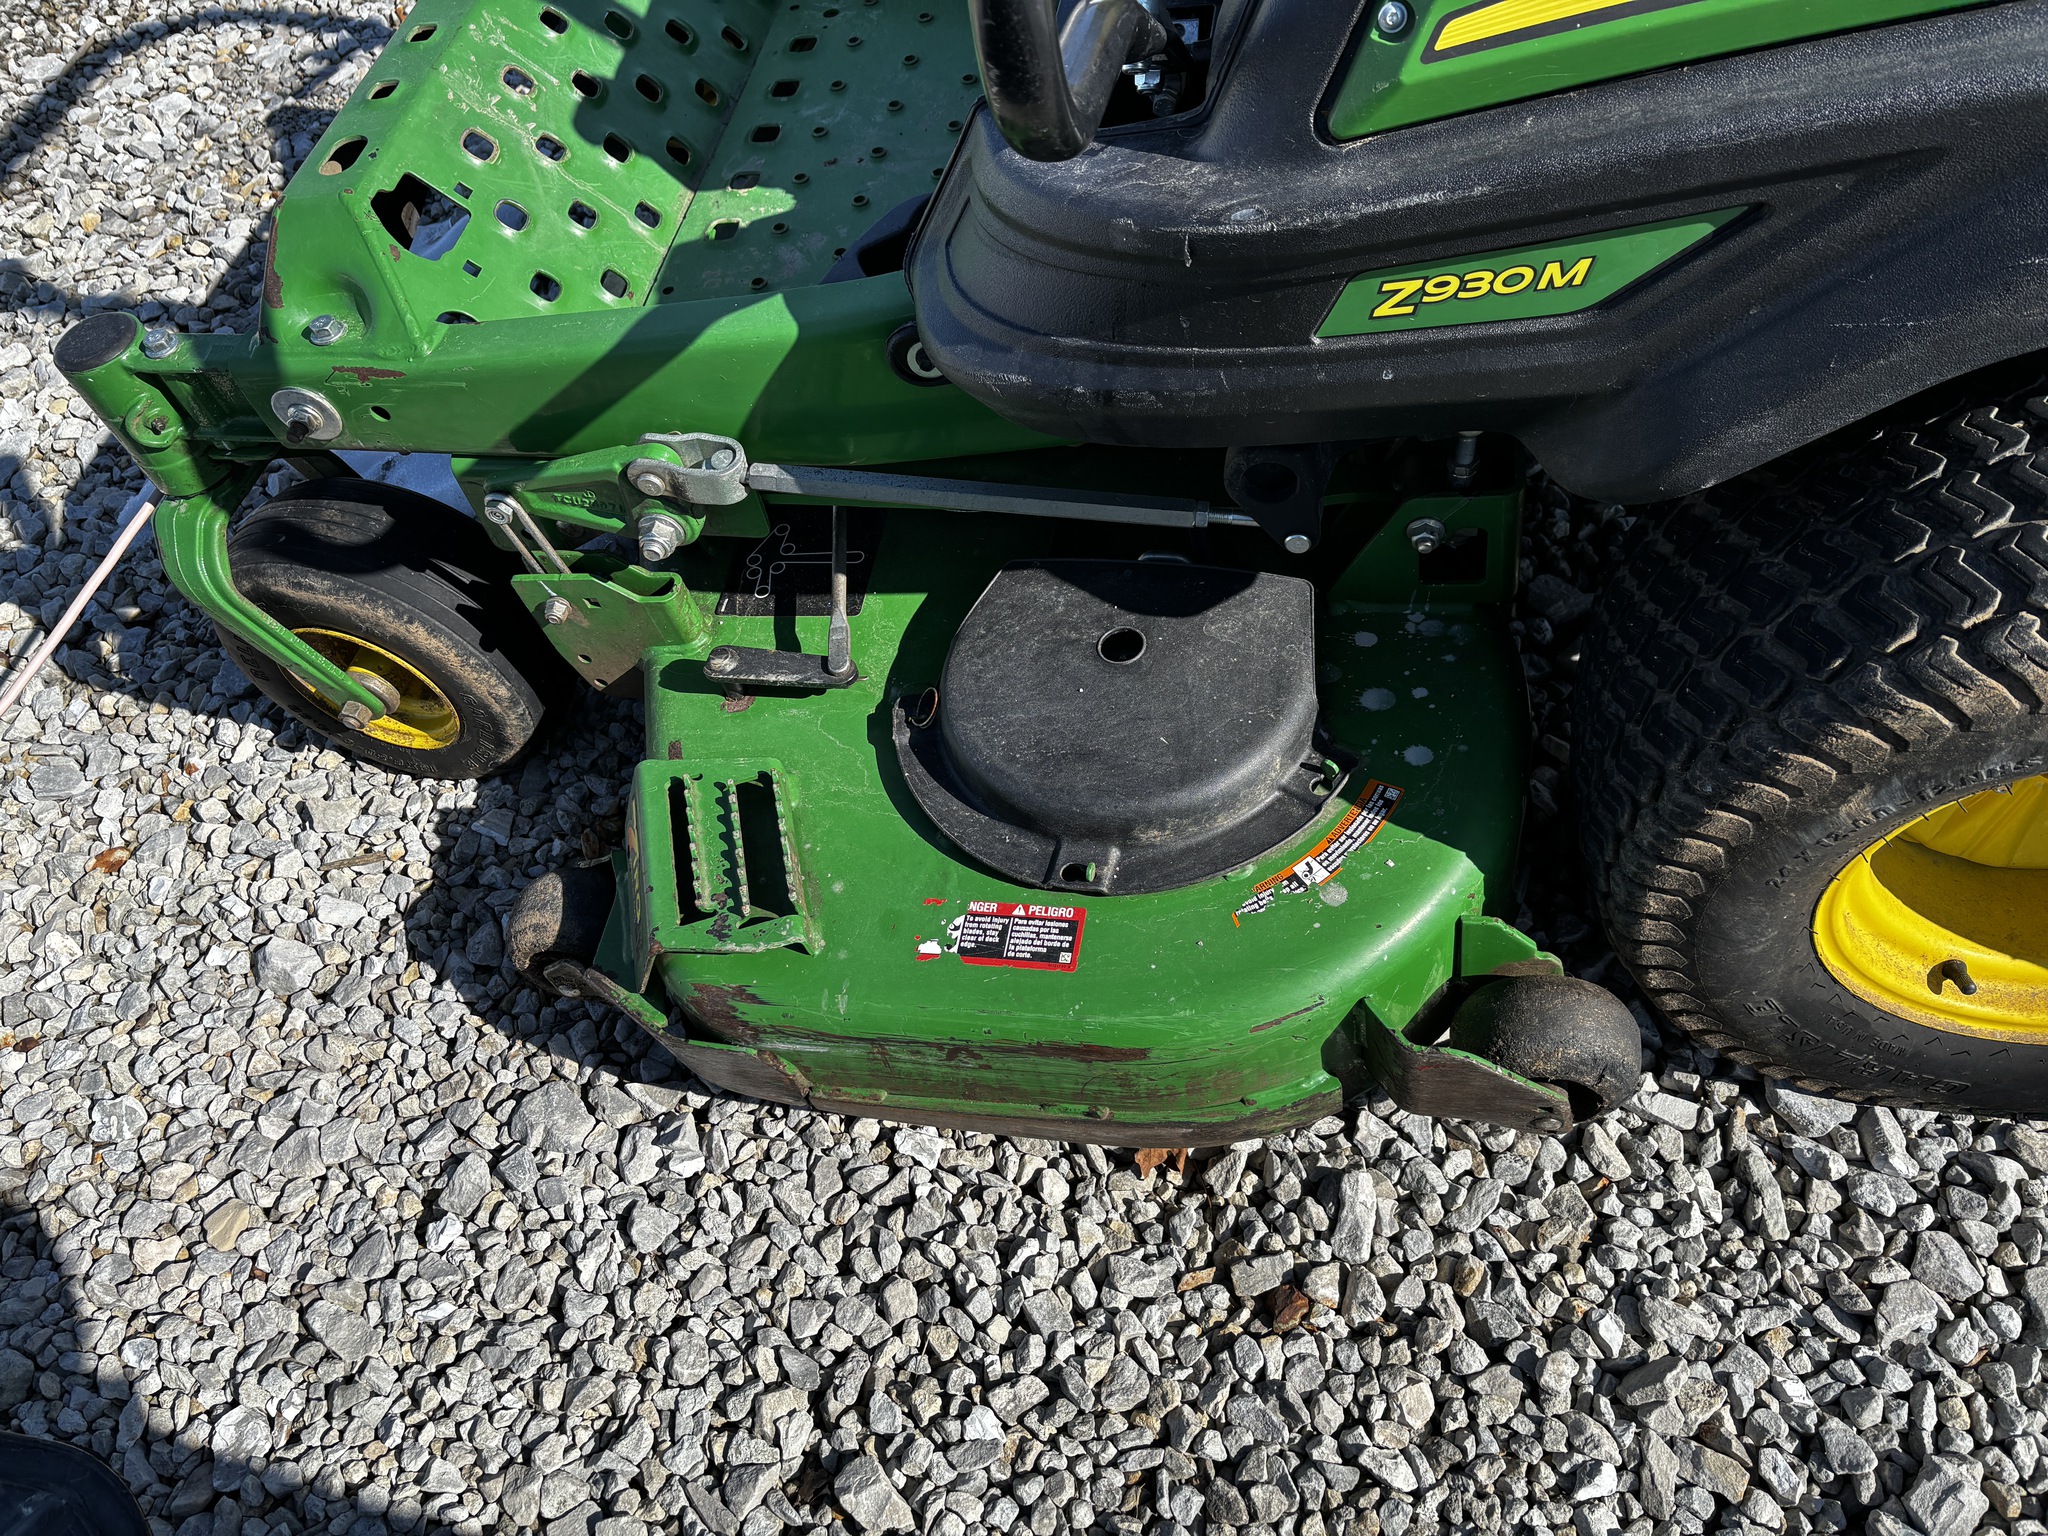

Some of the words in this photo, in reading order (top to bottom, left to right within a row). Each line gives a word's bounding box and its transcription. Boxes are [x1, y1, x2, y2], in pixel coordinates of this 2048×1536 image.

[1028, 907, 1074, 917] PELIGRO
[992, 916, 1009, 924] injury
[1045, 920, 1069, 928] lesiones
[980, 922, 1002, 930] rotating
[1011, 931, 1038, 939] cuchillas,
[960, 941, 977, 949] edge.
[1010, 938, 1032, 946] alejado
[1016, 945, 1047, 953] plataforma
[1872, 1036, 1905, 1057] MADE
